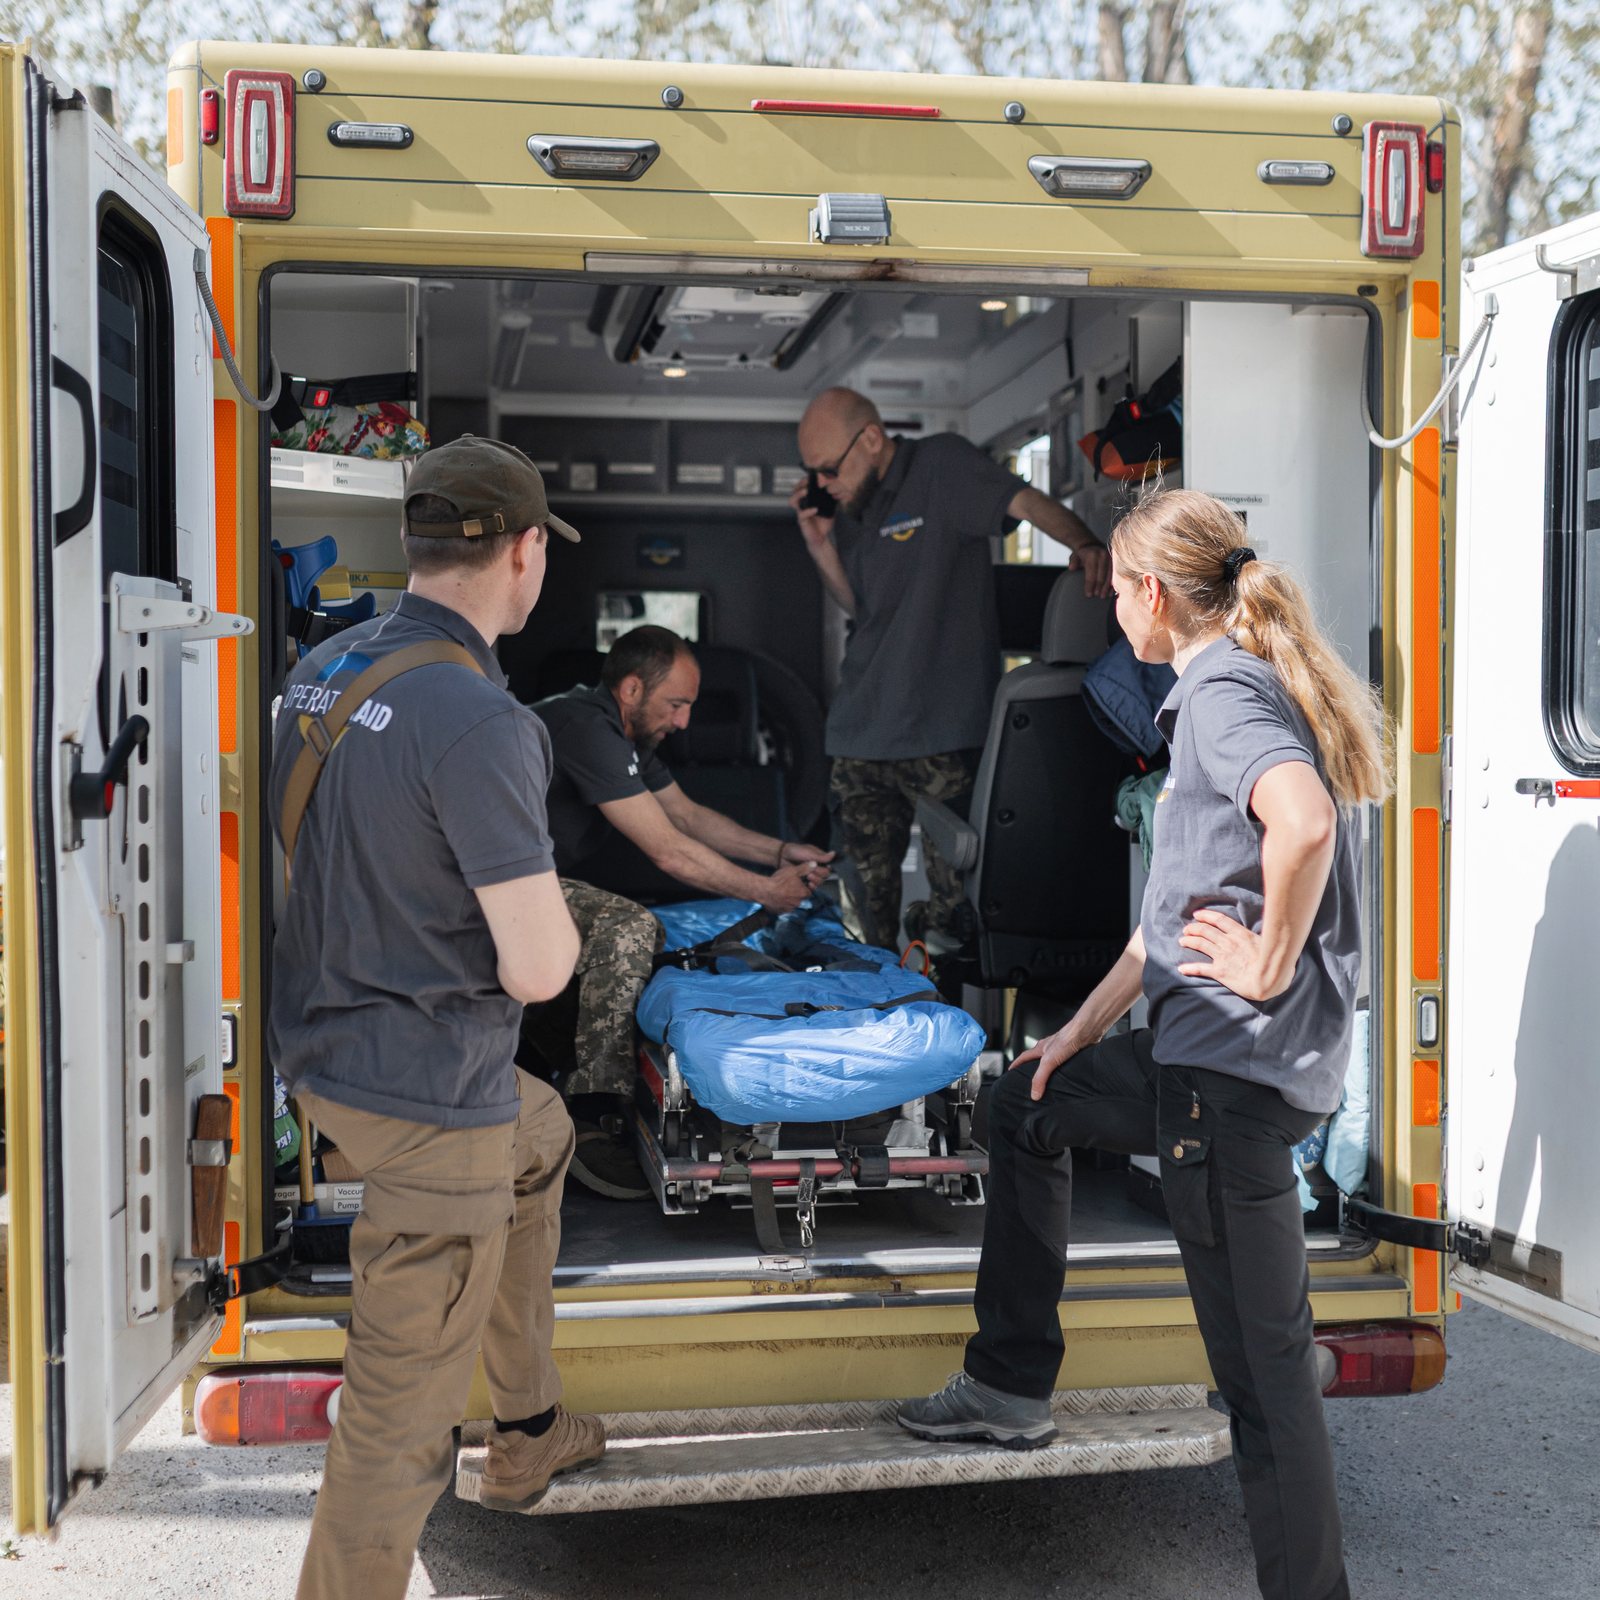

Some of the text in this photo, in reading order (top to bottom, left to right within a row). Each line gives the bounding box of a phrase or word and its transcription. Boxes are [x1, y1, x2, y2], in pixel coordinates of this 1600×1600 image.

[283, 684, 343, 716] OPERAT
[274, 1191, 296, 1199] ragar
[337, 1201, 360, 1209] Pump
